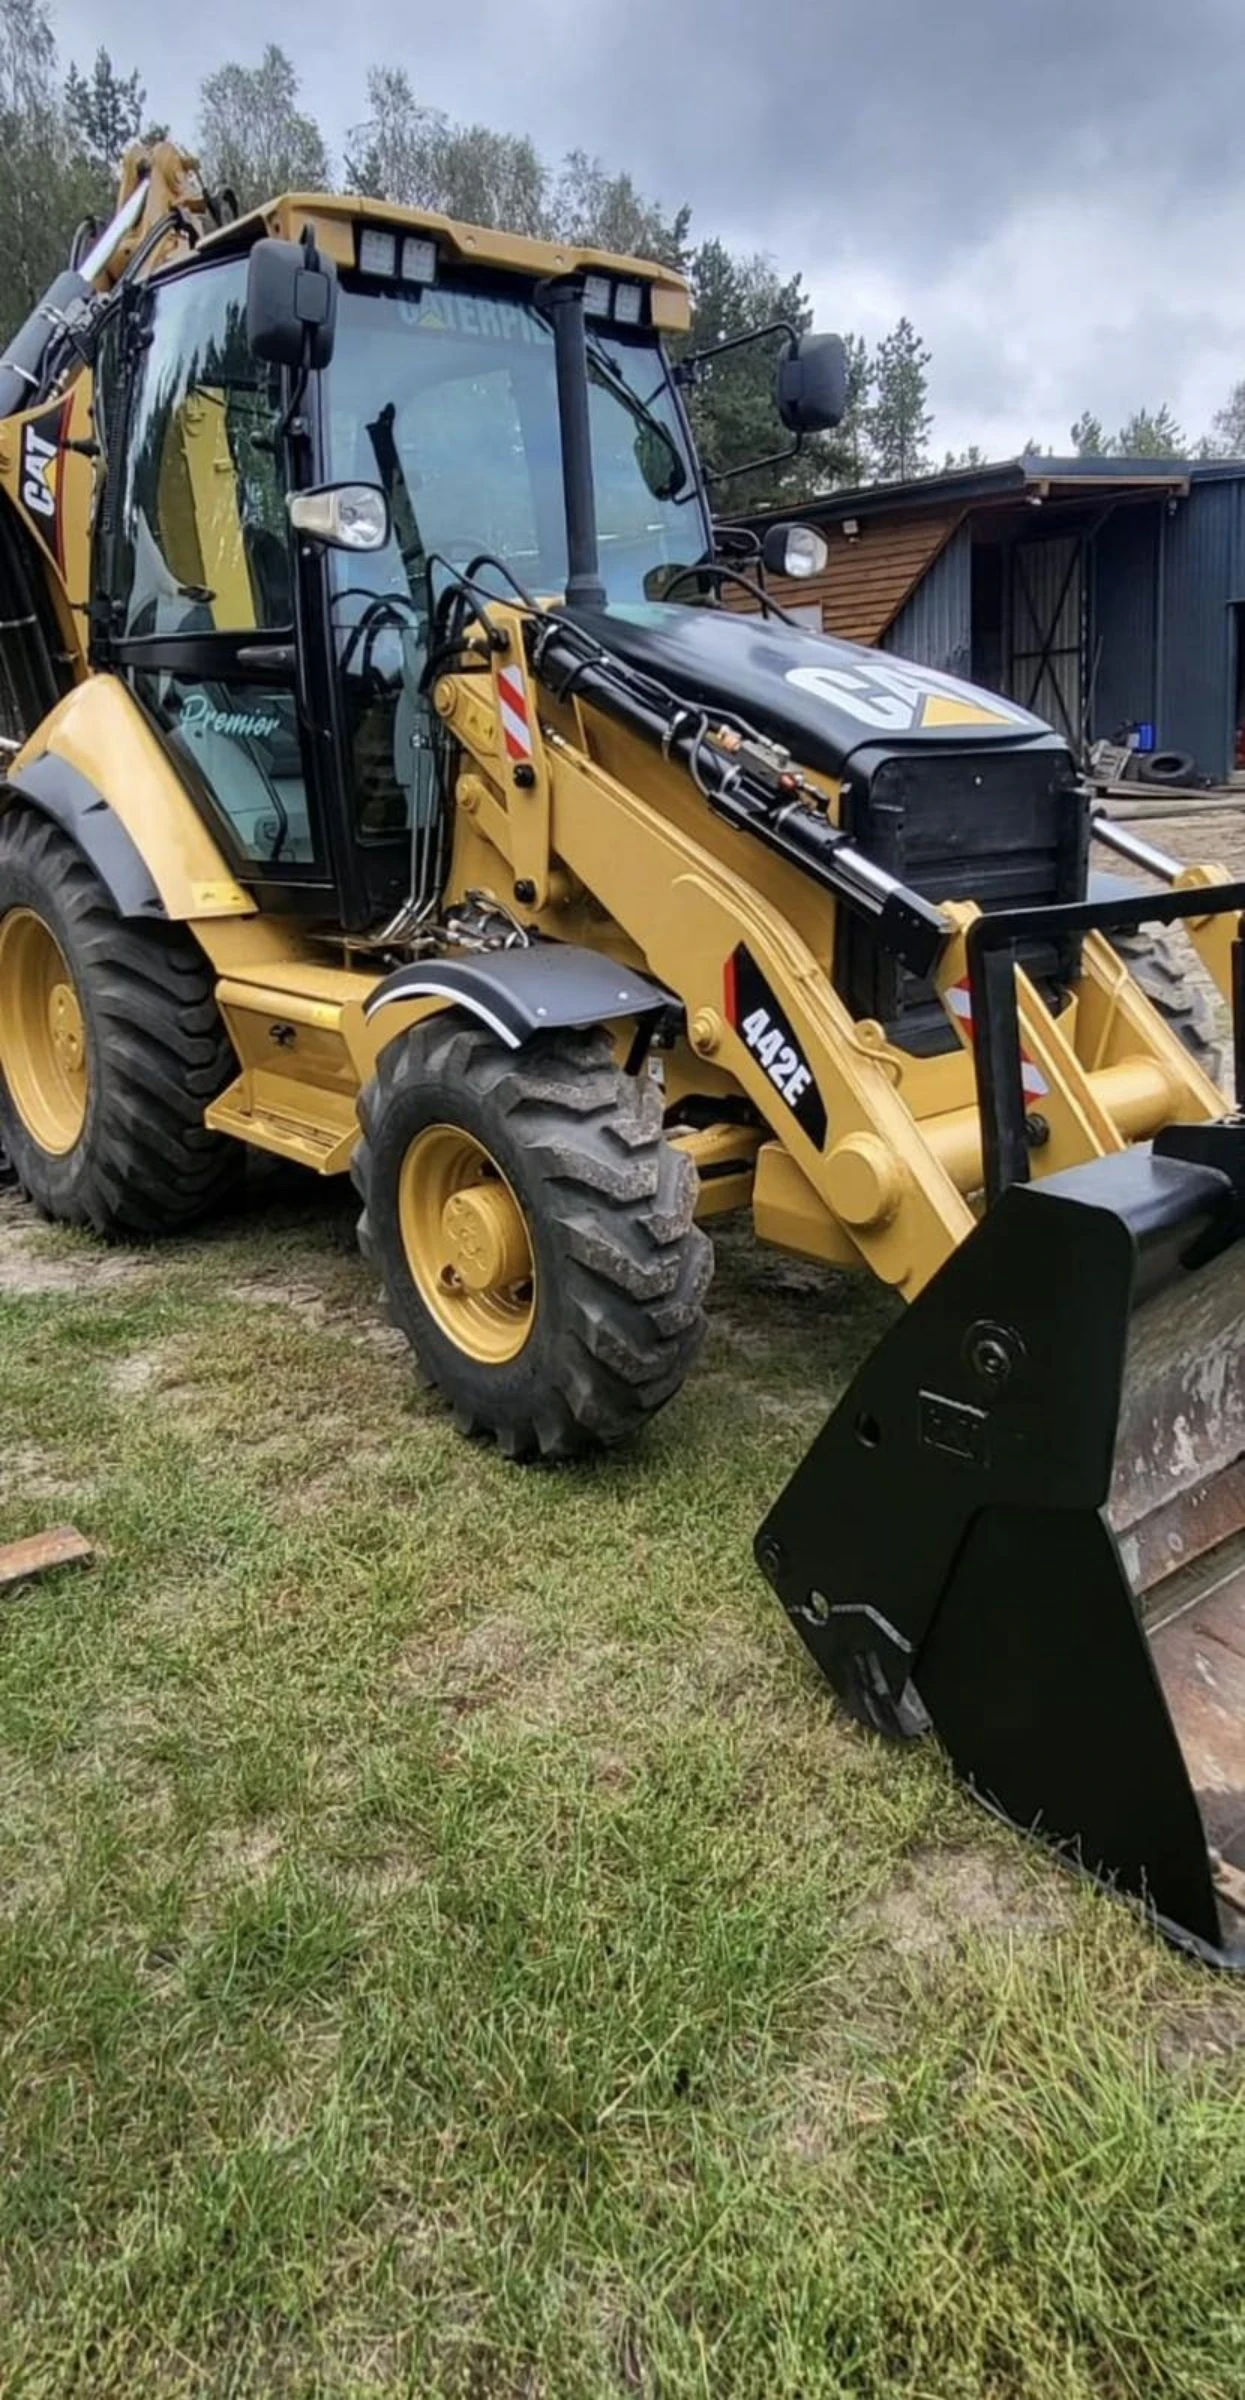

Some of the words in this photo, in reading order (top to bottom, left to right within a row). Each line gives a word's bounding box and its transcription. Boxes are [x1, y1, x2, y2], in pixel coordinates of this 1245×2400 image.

[23, 424, 58, 517] CAT
[180, 695, 280, 737] Premier
[741, 1007, 812, 1107] 442E
